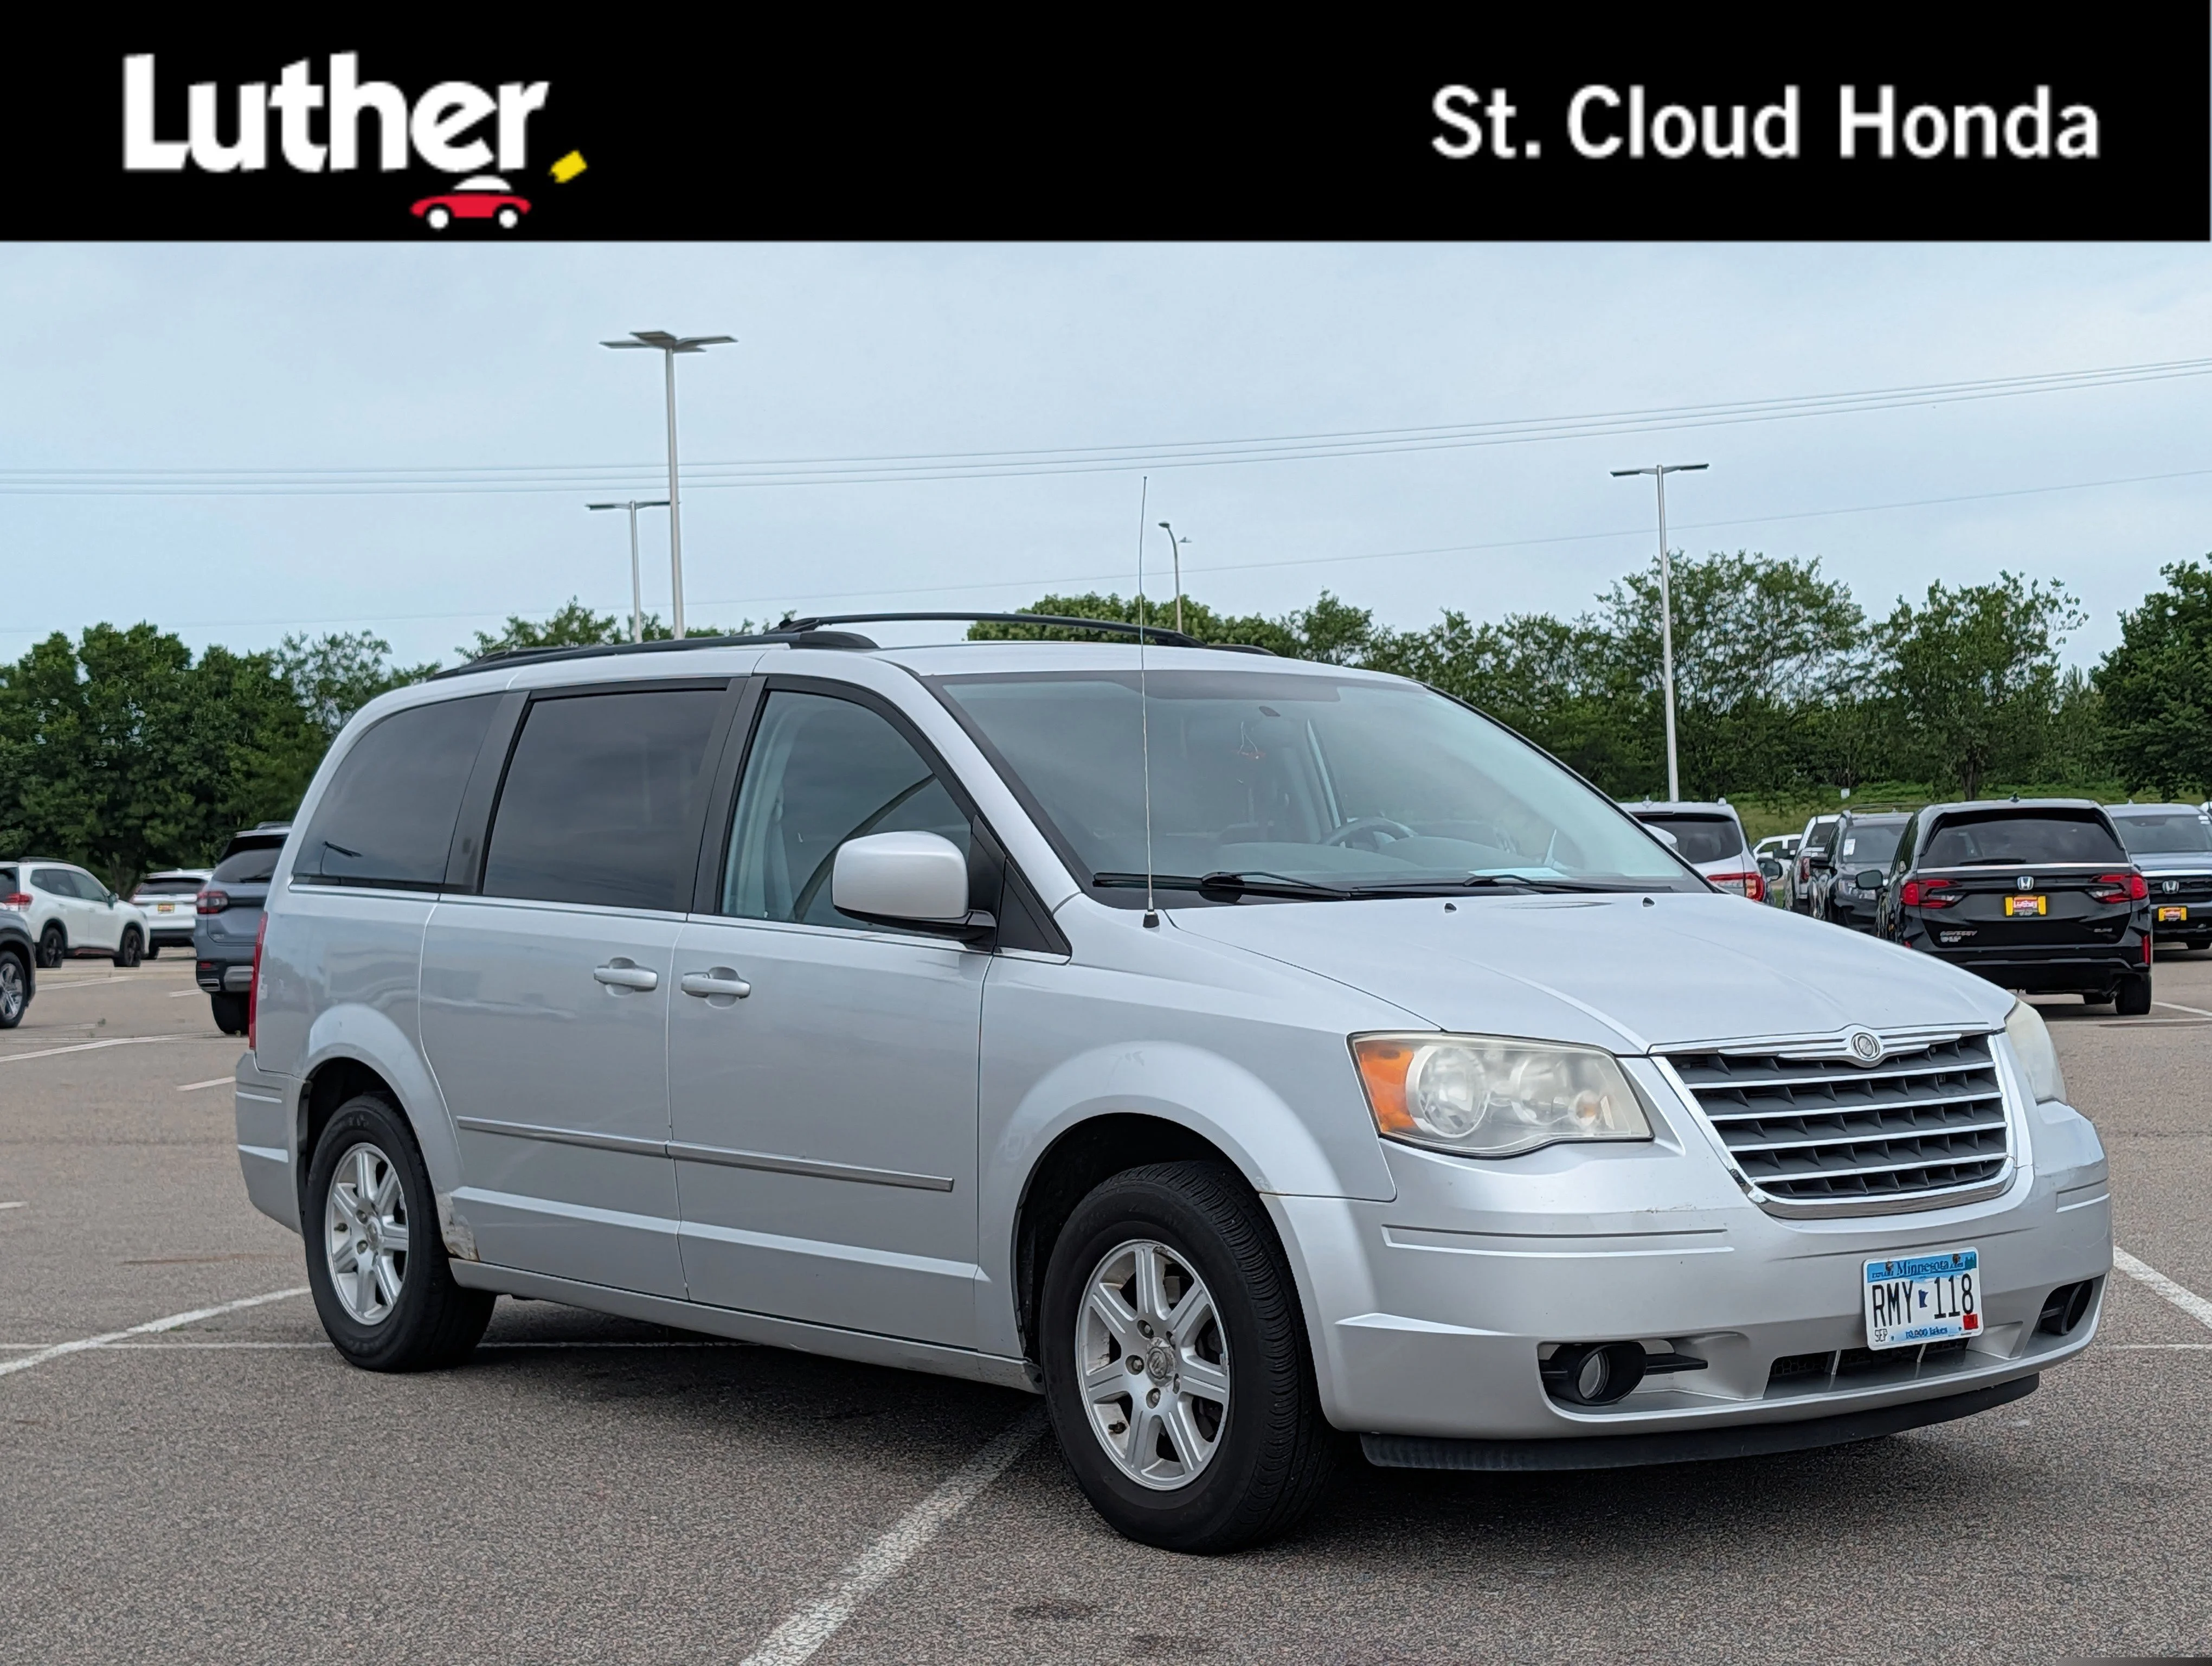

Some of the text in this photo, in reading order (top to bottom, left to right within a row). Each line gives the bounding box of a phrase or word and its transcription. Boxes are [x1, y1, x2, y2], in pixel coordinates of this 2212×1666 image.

[1897, 1260, 1949, 1276] Minnesota
[1872, 1273, 1974, 1328] RMY 118
